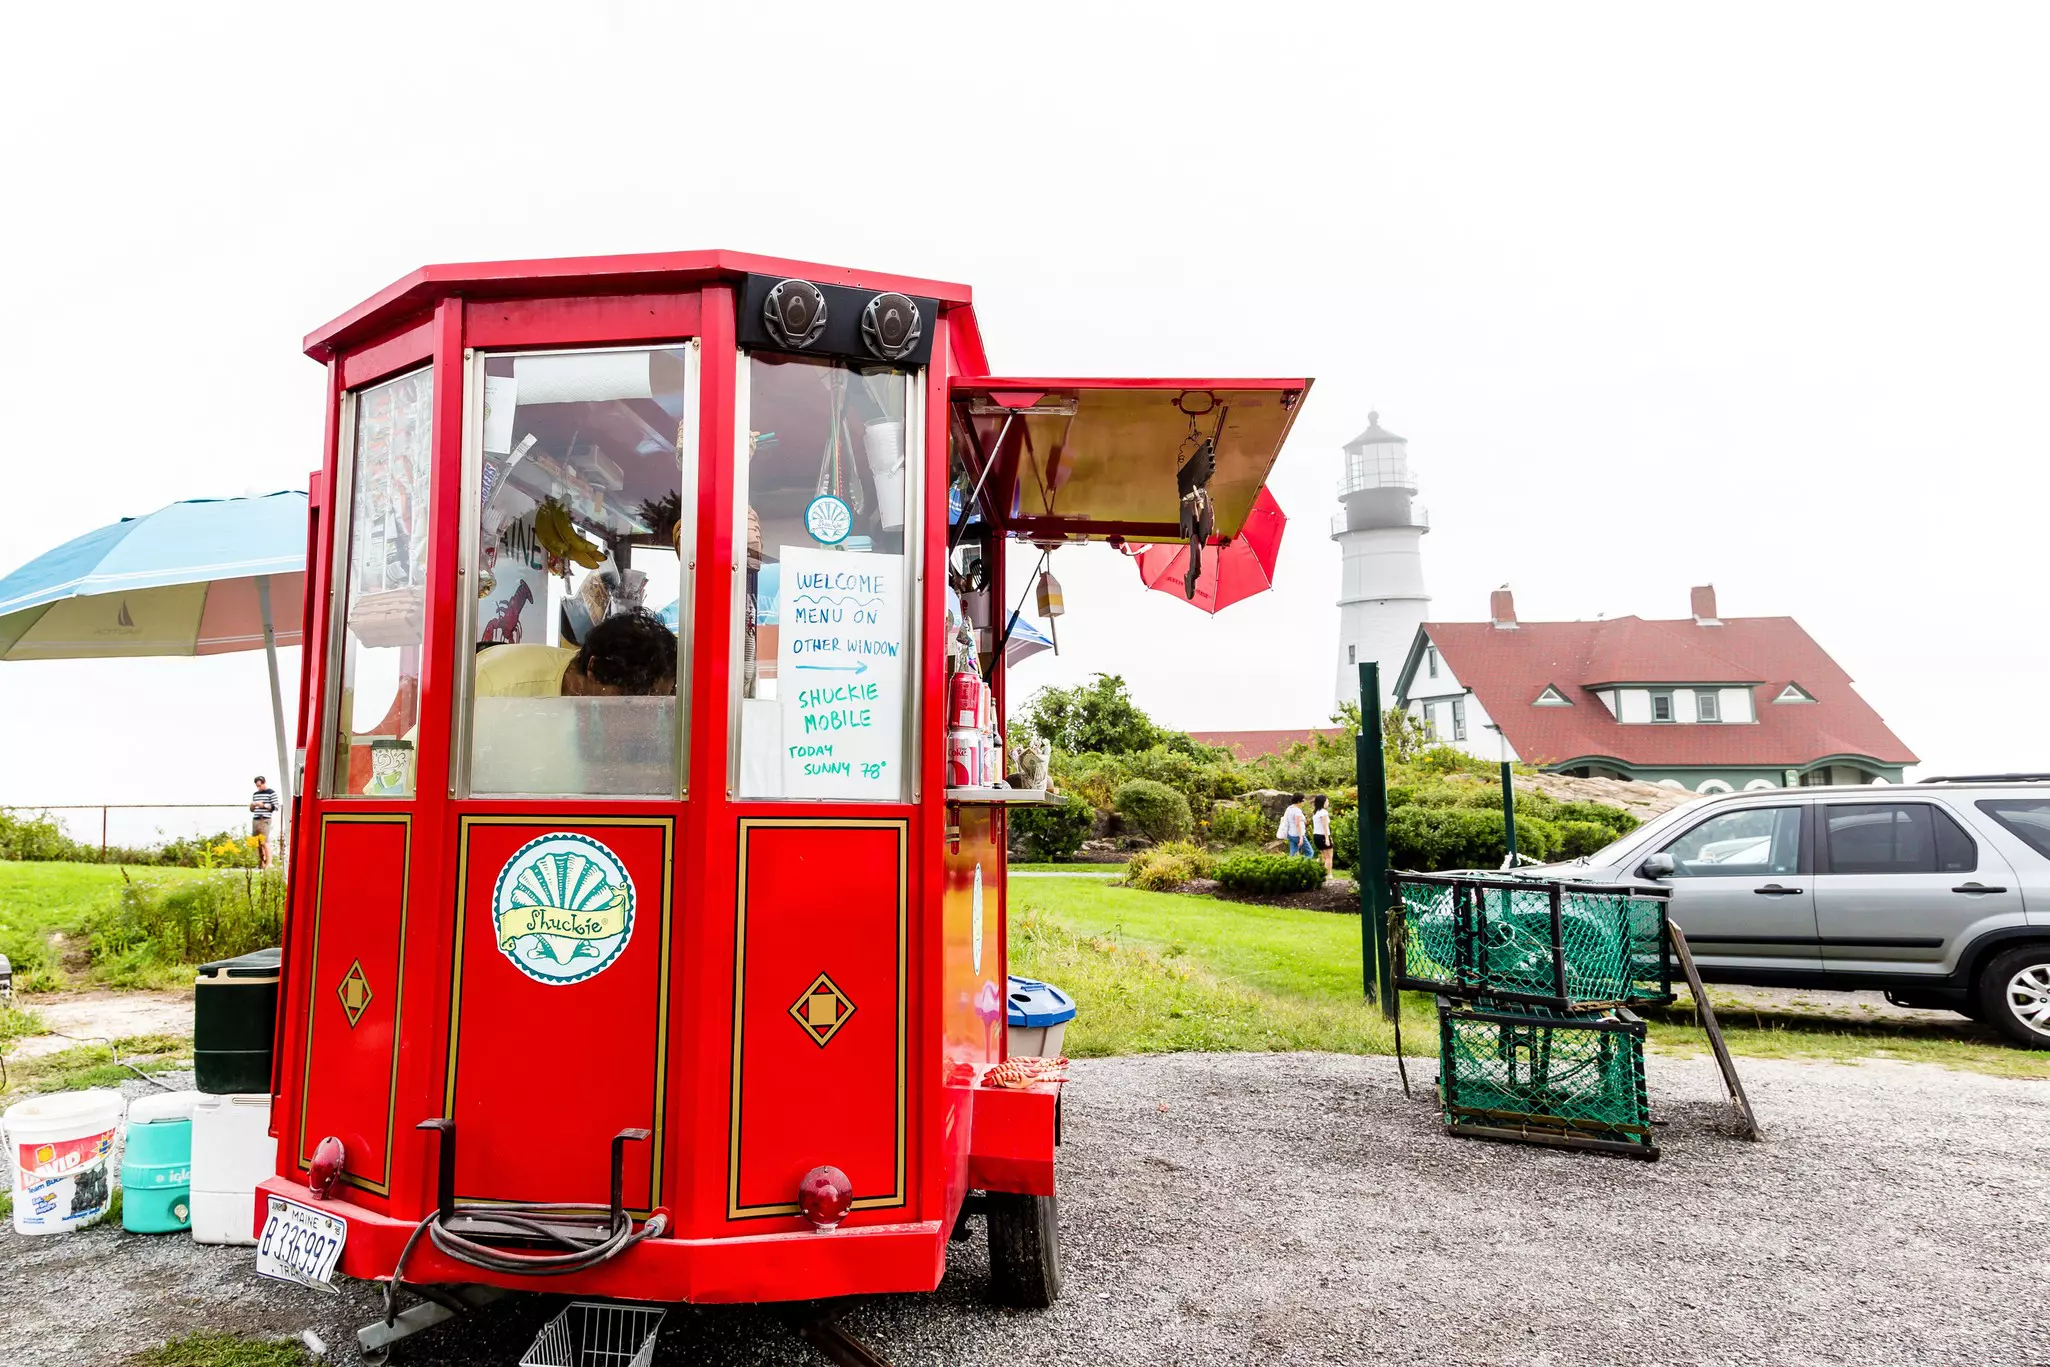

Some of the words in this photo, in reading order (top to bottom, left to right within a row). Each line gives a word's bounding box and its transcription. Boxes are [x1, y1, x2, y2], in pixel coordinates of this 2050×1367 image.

[796, 572, 886, 594] WELCOME
[795, 608, 843, 624] MENU
[853, 609, 878, 625] ON
[793, 637, 843, 654] OTHER
[798, 683, 879, 709] SHUCKIE
[804, 709, 872, 734] MOBILE
[788, 744, 833, 759] TODAY
[804, 762, 851, 777] SUNNY
[860, 760, 887, 779] 78°
[526, 908, 603, 935] Shuckie
[291, 1210, 319, 1229] MAINE
